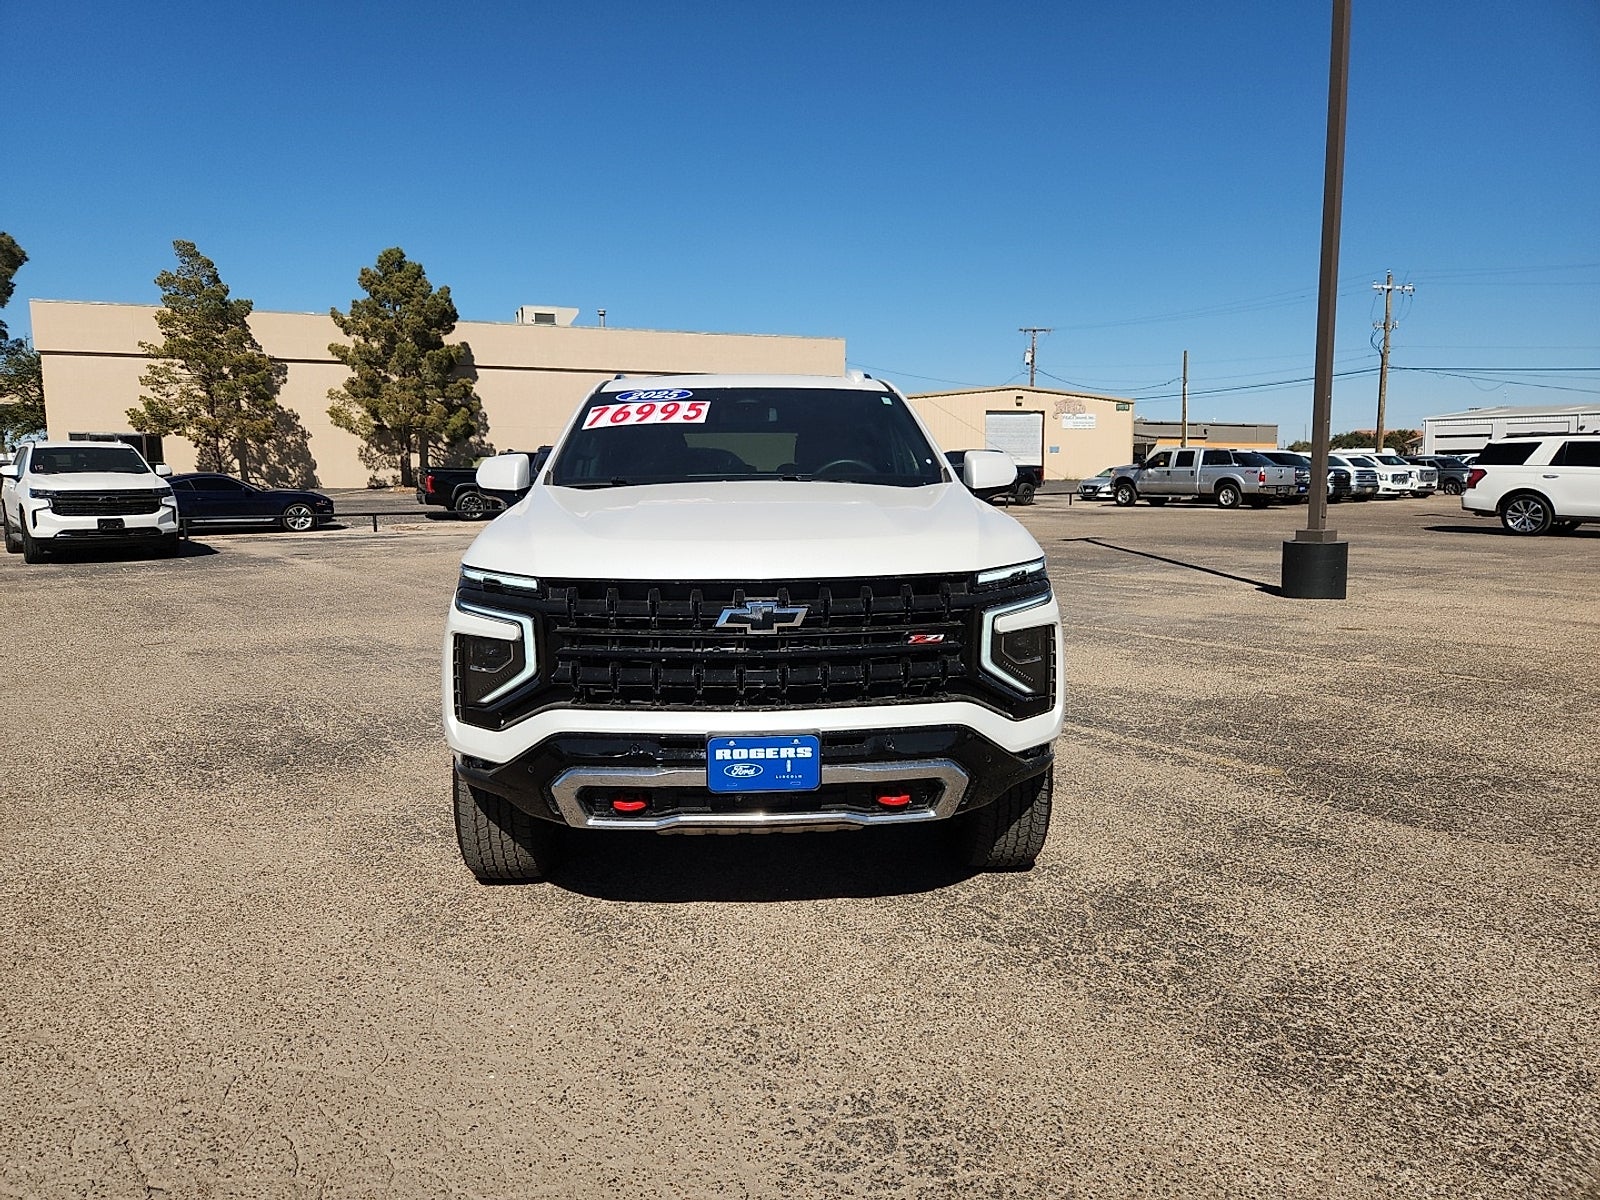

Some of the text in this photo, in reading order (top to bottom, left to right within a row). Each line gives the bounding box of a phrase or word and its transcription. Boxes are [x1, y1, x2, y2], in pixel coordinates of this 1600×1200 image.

[628, 389, 679, 400] 2025
[587, 402, 707, 427] 76995
[715, 747, 813, 760] ROGERS
[731, 764, 756, 776] Ford
